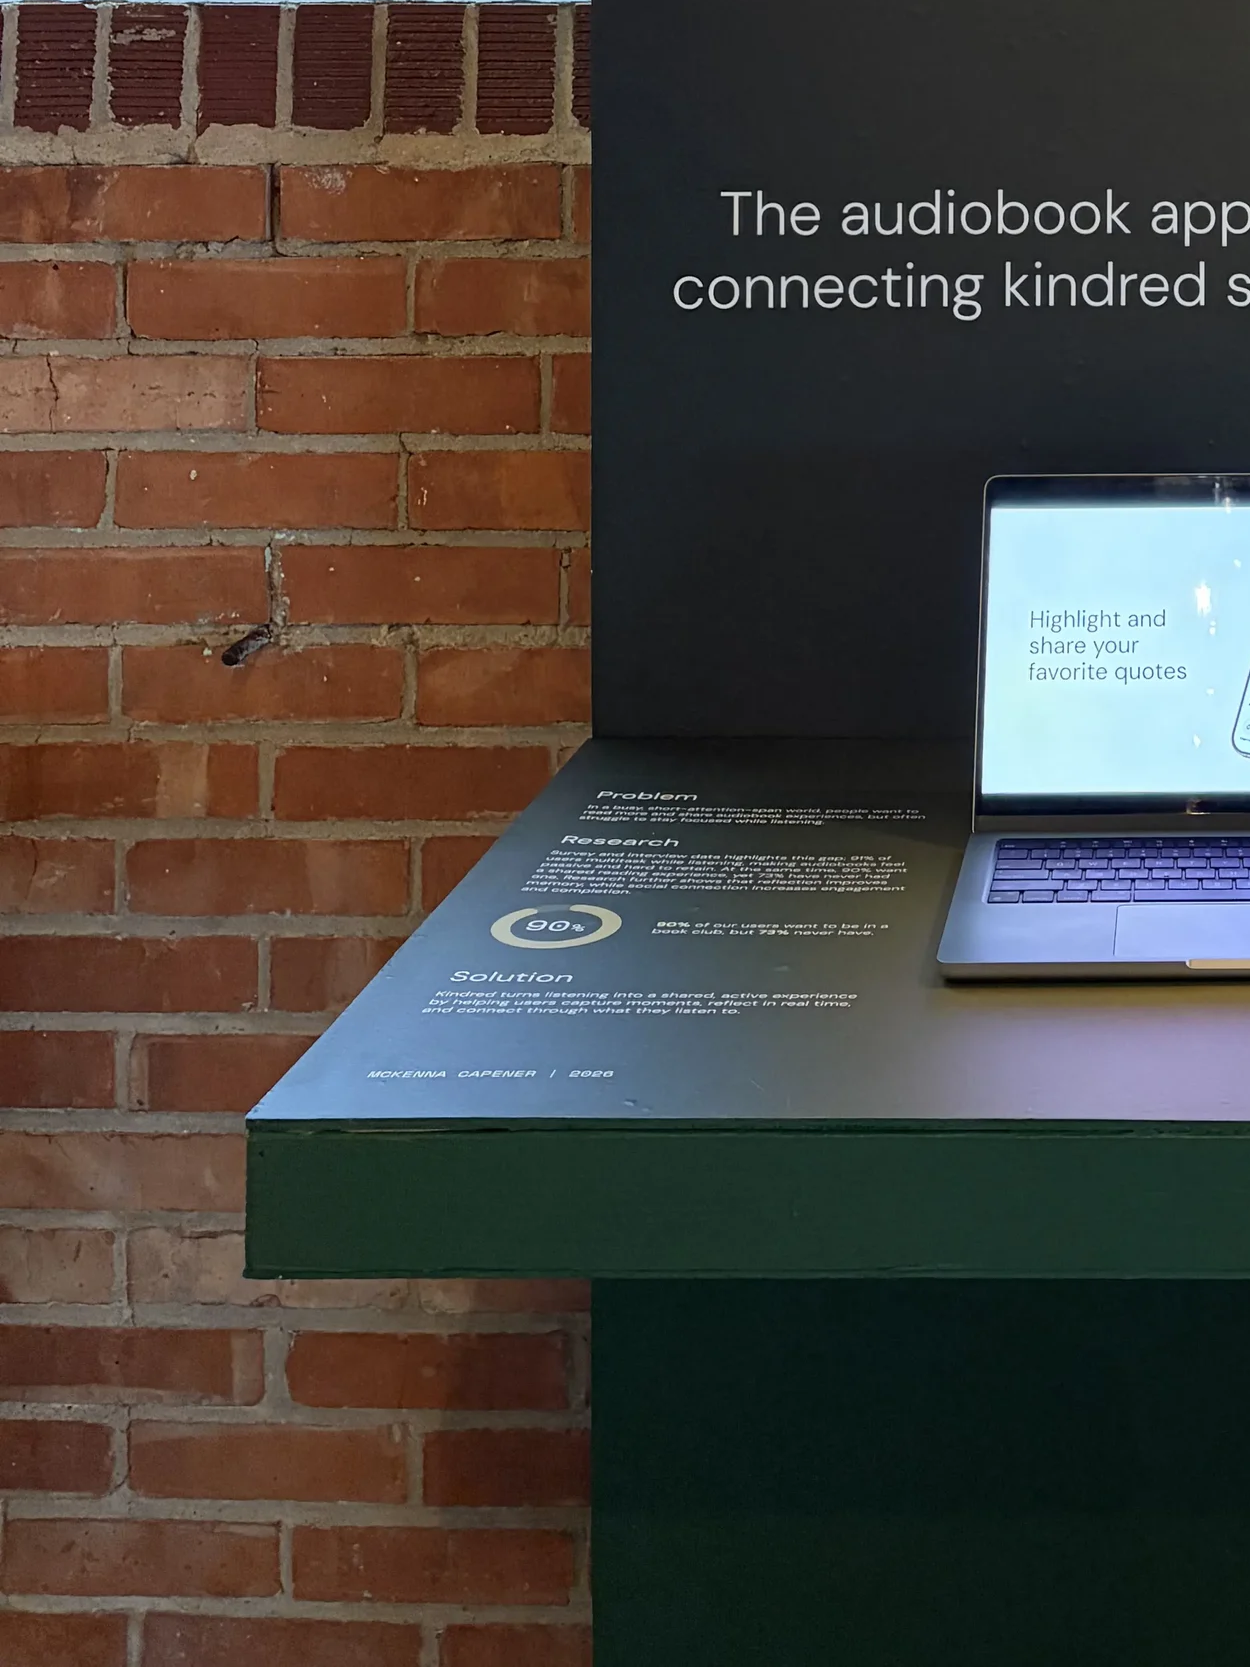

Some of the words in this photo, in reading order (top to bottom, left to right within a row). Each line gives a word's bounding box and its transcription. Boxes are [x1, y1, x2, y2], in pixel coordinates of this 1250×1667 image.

[720, 189, 821, 237] The
[841, 188, 1132, 236] audiobook
[673, 261, 985, 322] connecting
[1004, 260, 1206, 308] kindred
[1030, 609, 1123, 632] Highlight
[1127, 609, 1166, 628] and
[1029, 636, 1086, 655] share
[1093, 640, 1139, 658] your
[1028, 662, 1107, 681] favorite
[1114, 663, 1187, 684] quotes
[596, 791, 698, 800] Problem
[561, 835, 679, 847] Research
[525, 920, 585, 932] 90%
[450, 970, 573, 983] Solution
[435, 990, 497, 998] Kindred
[544, 991, 609, 1000] listening
[661, 992, 715, 1000] shared,
[452, 999, 508, 1007] helping
[527, 1007, 588, 1015] through
[367, 1070, 446, 1078] MCKENNA
[457, 1070, 537, 1078] CAPENER
[568, 1070, 614, 1078] 2026
